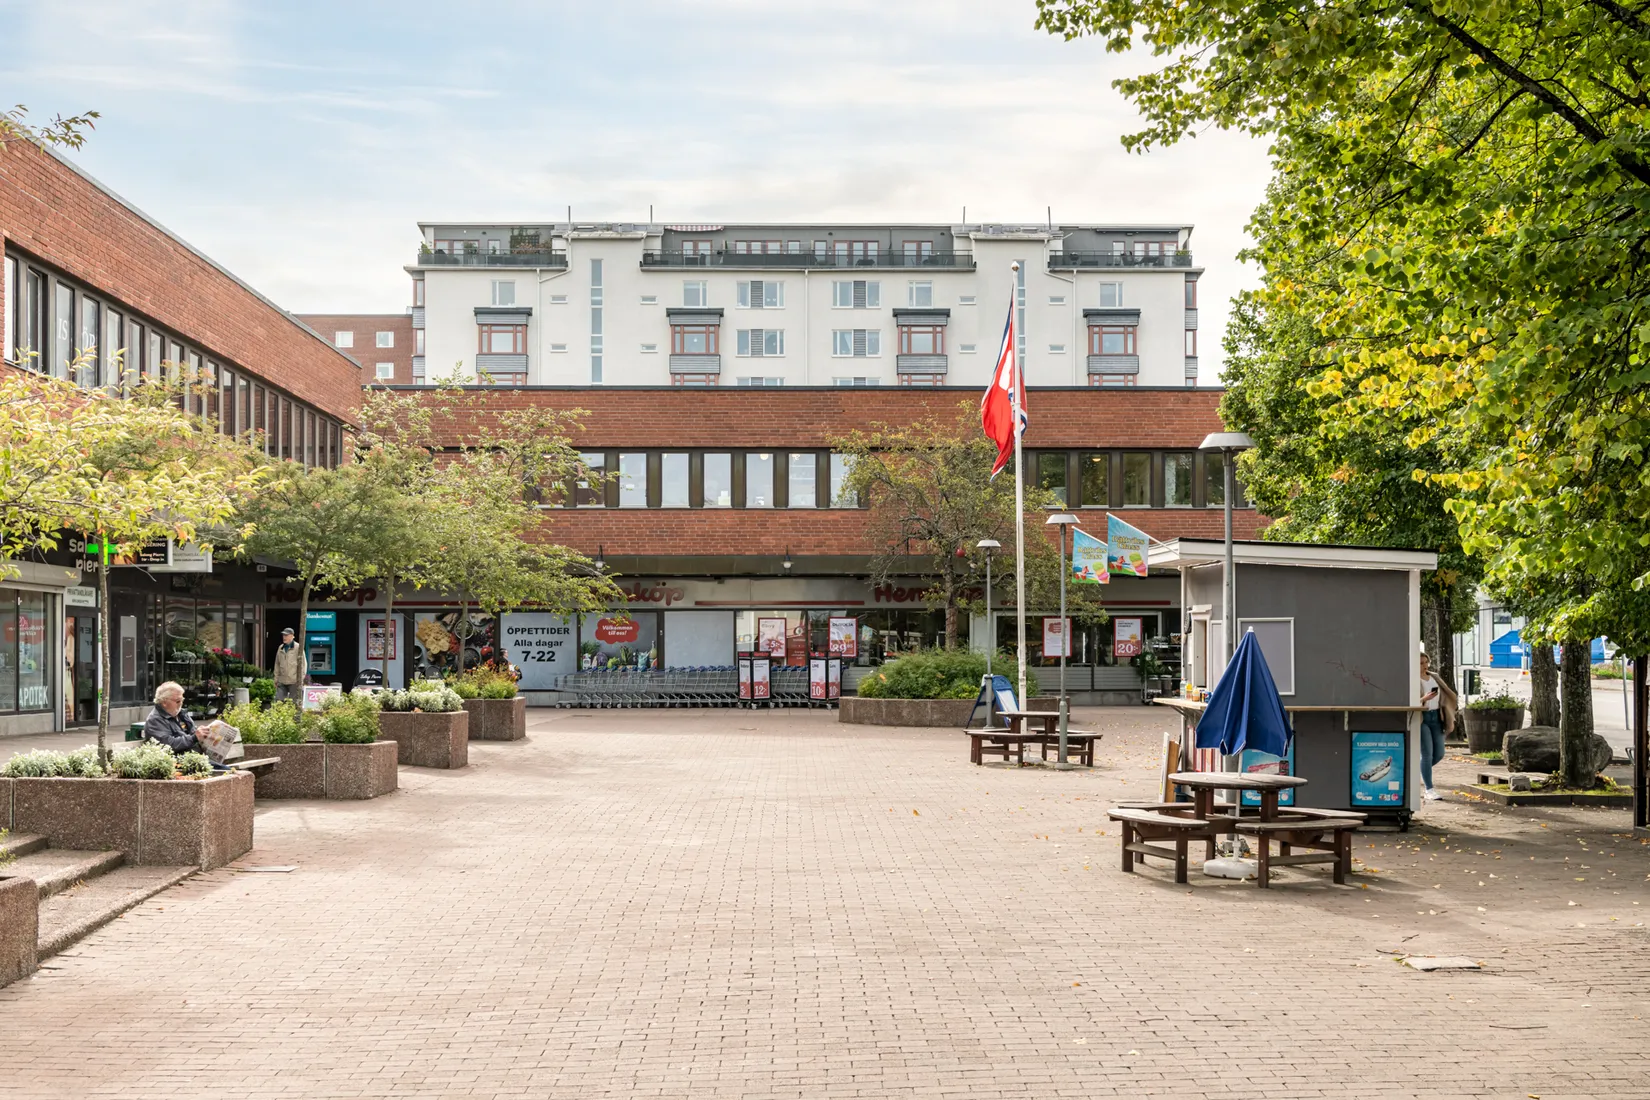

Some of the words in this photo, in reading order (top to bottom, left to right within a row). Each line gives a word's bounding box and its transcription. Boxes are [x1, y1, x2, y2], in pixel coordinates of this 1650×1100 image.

[58, 318, 68, 340] IS
[265, 580, 377, 607] Hemöp
[874, 582, 985, 606] Hemp
[507, 626, 570, 635] ÖPPETTIDER
[514, 639, 533, 647] Alla
[535, 639, 564, 649] dagar
[521, 650, 556, 662] 7-22
[18, 685, 49, 707] APOTEK
